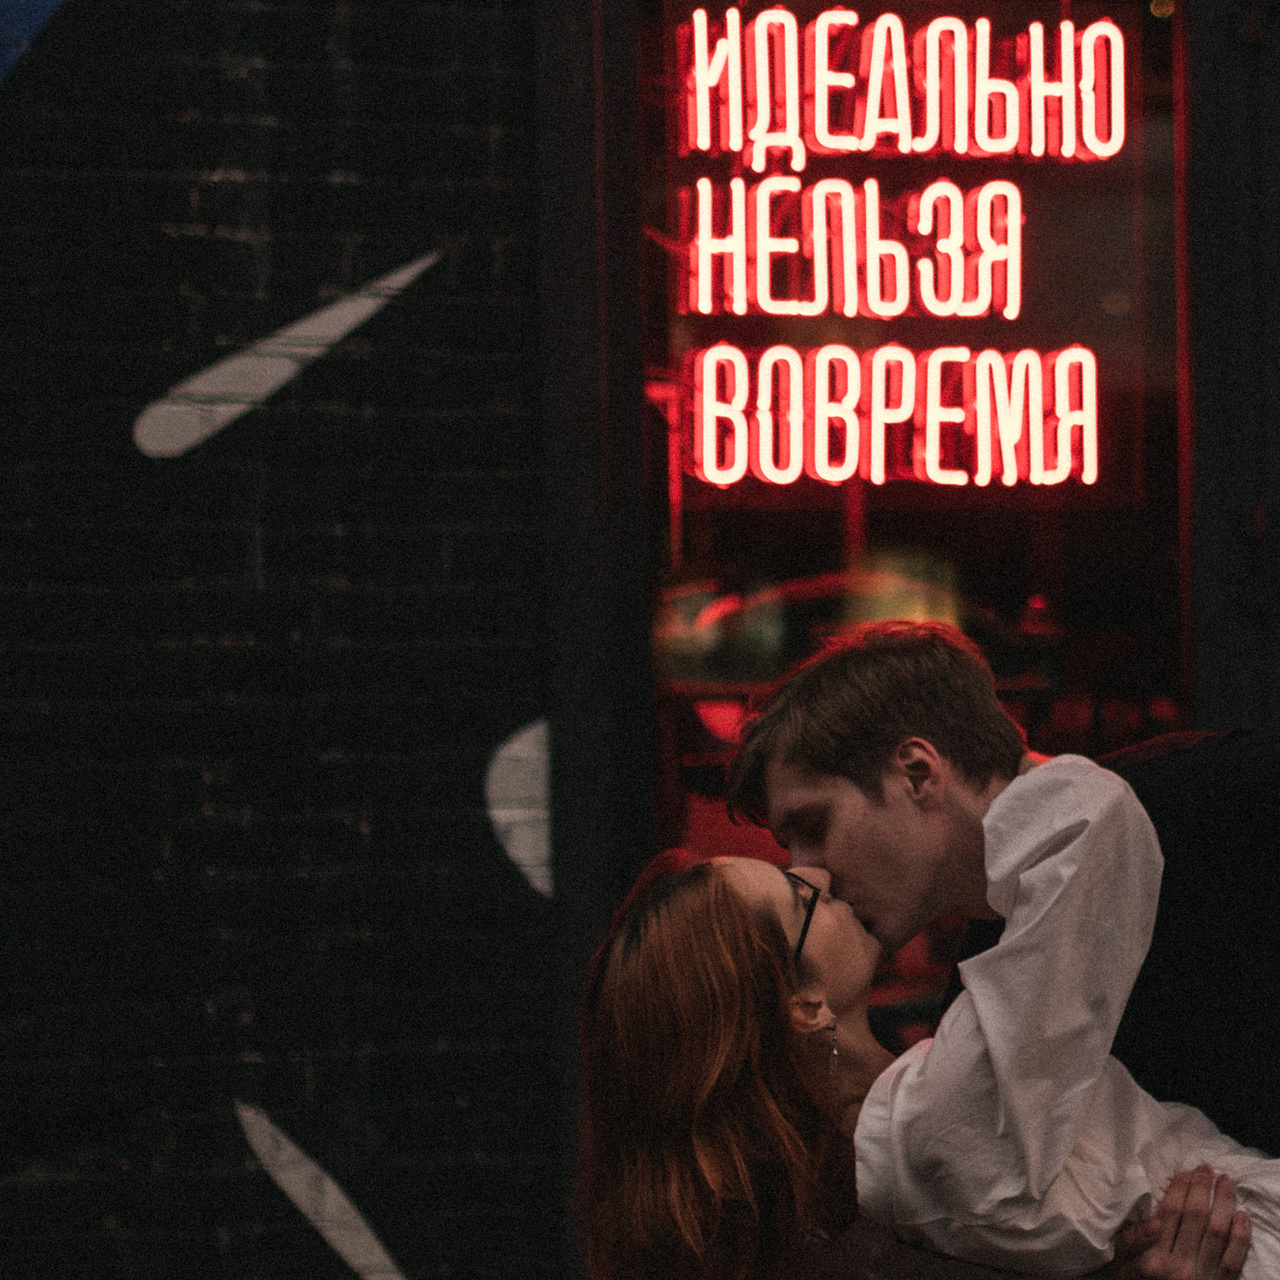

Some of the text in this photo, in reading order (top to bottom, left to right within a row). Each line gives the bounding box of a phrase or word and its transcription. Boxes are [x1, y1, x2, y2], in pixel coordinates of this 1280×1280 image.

[690, 6, 1126, 174] ИДЕАЛЬНО
[692, 176, 1023, 321] НЕЛЬЗЯ
[699, 343, 1099, 488] ВОВРЕМЯ
